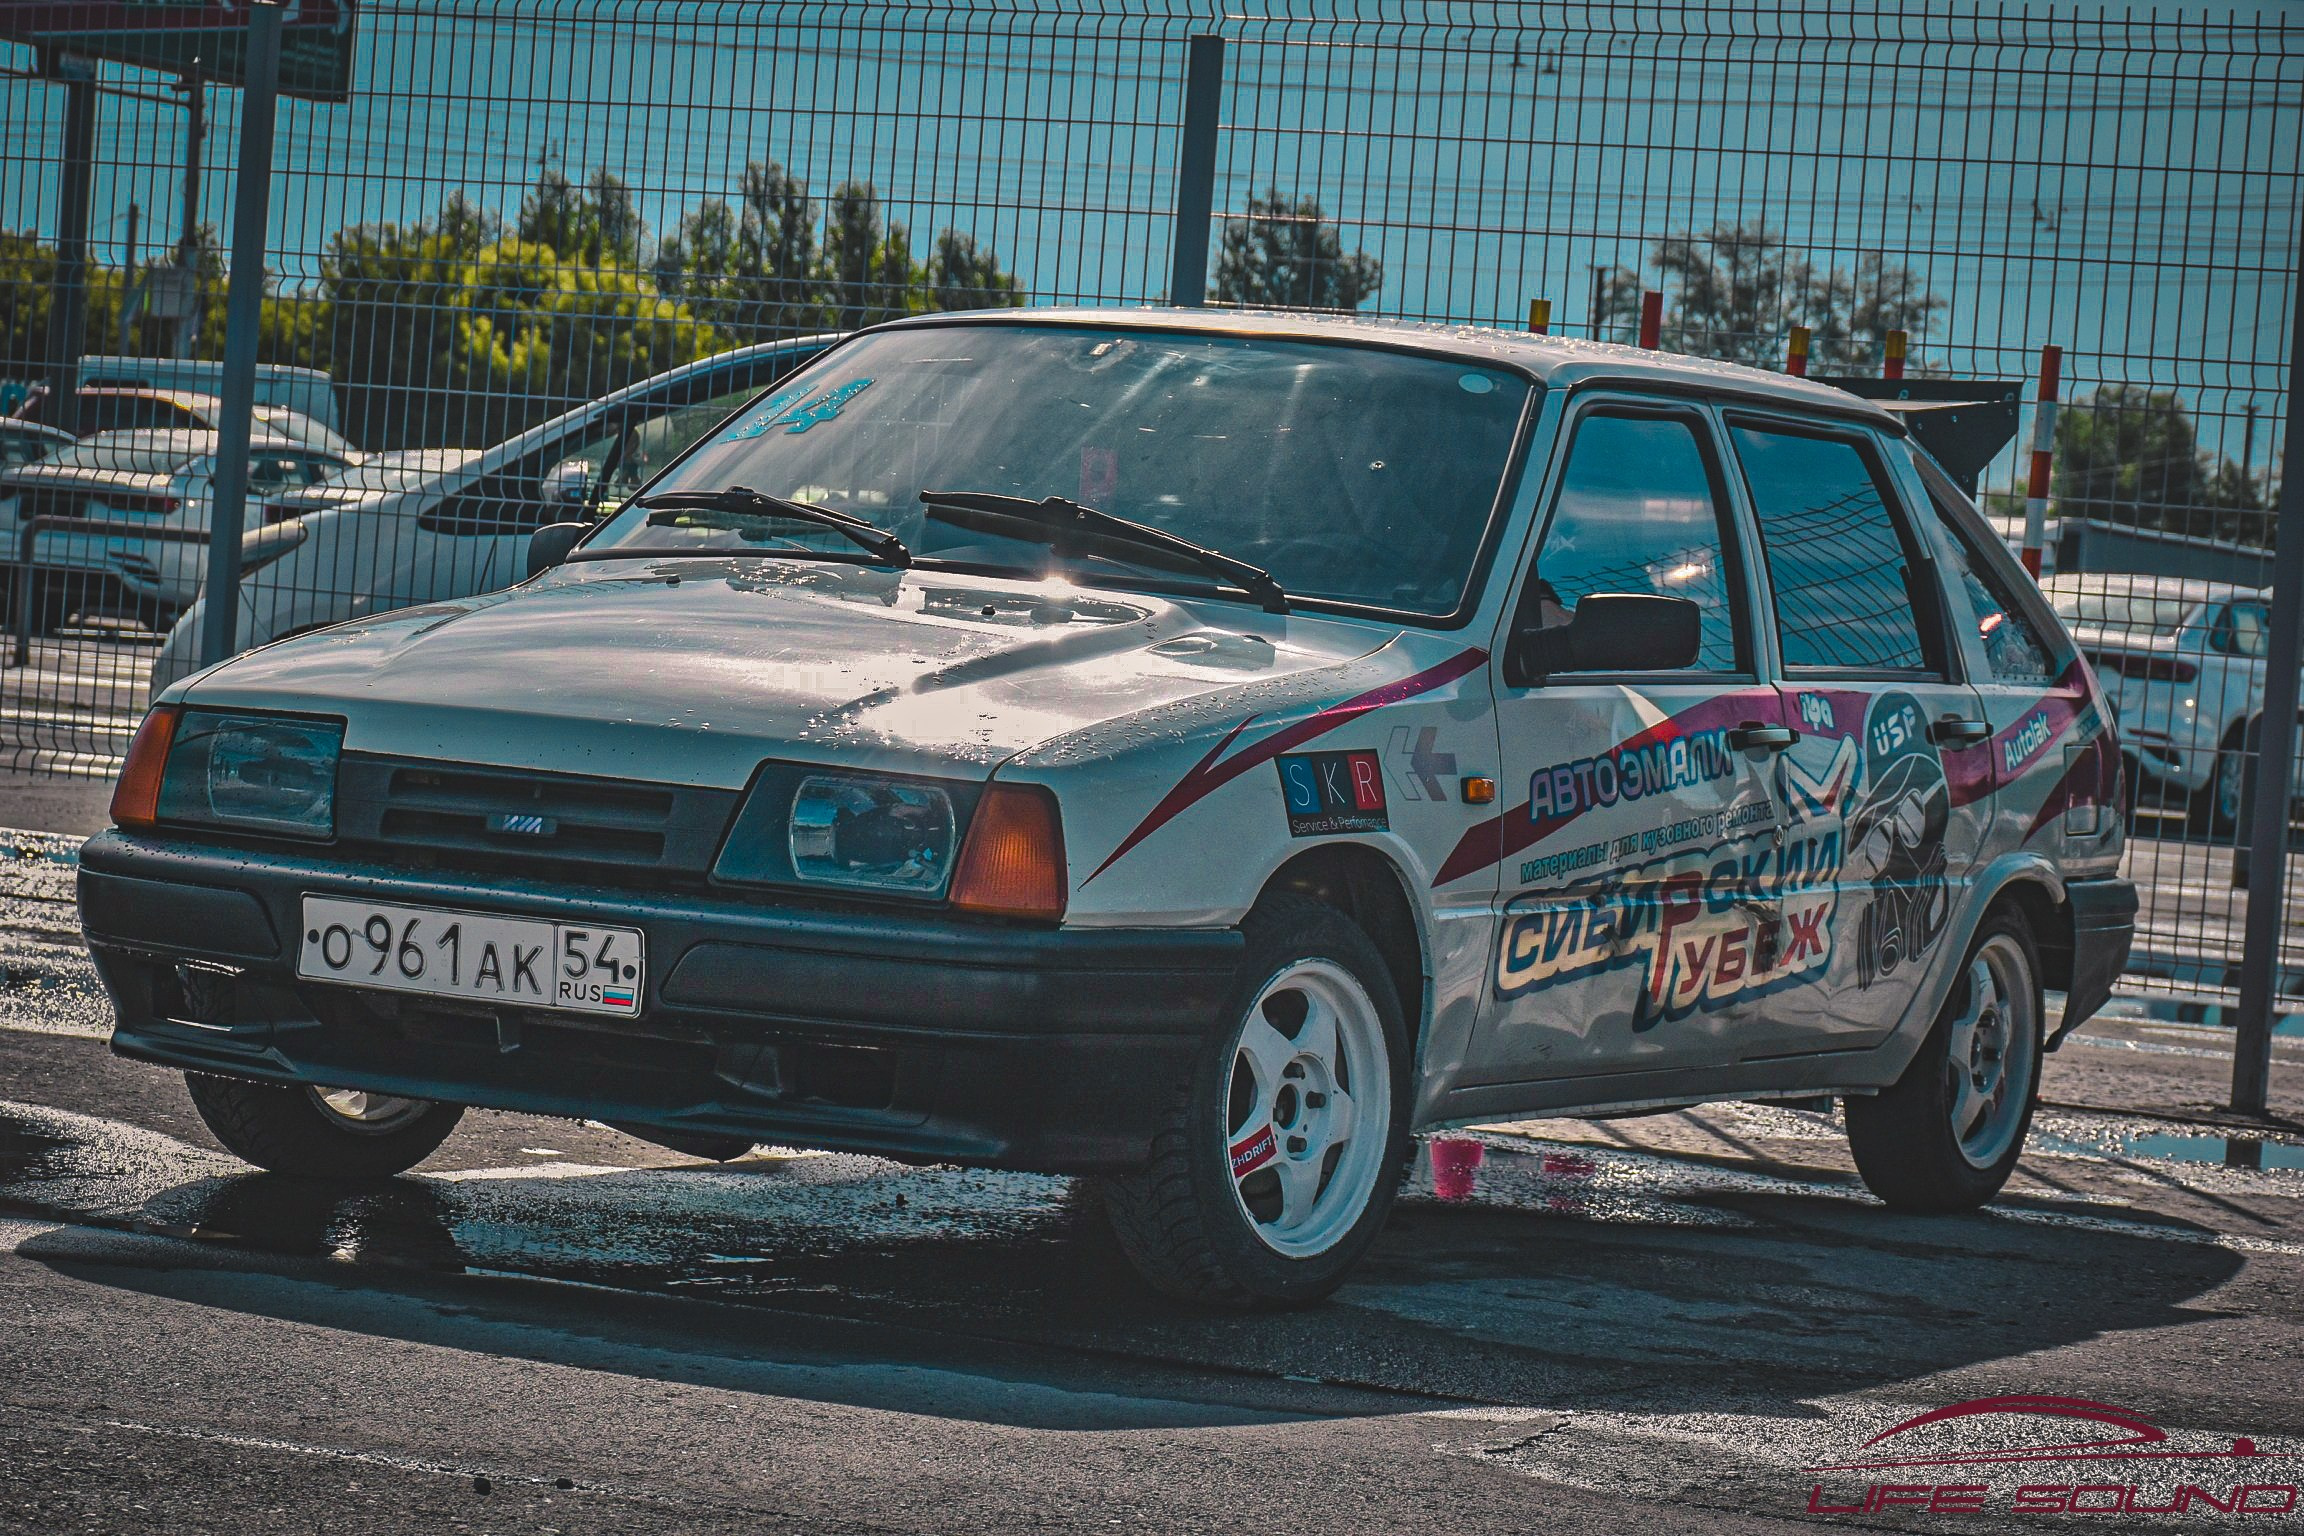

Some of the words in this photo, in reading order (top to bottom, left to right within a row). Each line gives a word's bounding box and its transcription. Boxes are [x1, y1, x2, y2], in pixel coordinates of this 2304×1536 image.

[1872, 704, 1917, 756] USP
[2004, 711, 2052, 773] Autolak
[1288, 760, 1379, 807] SKR
[1530, 727, 1736, 823] АВТОЭМАЛИ
[1292, 819, 1329, 834] Service
[1328, 816, 1338, 830] &
[1520, 840, 1609, 884] материалы
[1609, 833, 1639, 864] для
[1641, 816, 1715, 856] кузовного
[1716, 800, 1775, 838] ремонта
[562, 929, 621, 985] 54
[558, 981, 602, 1003] RUS
